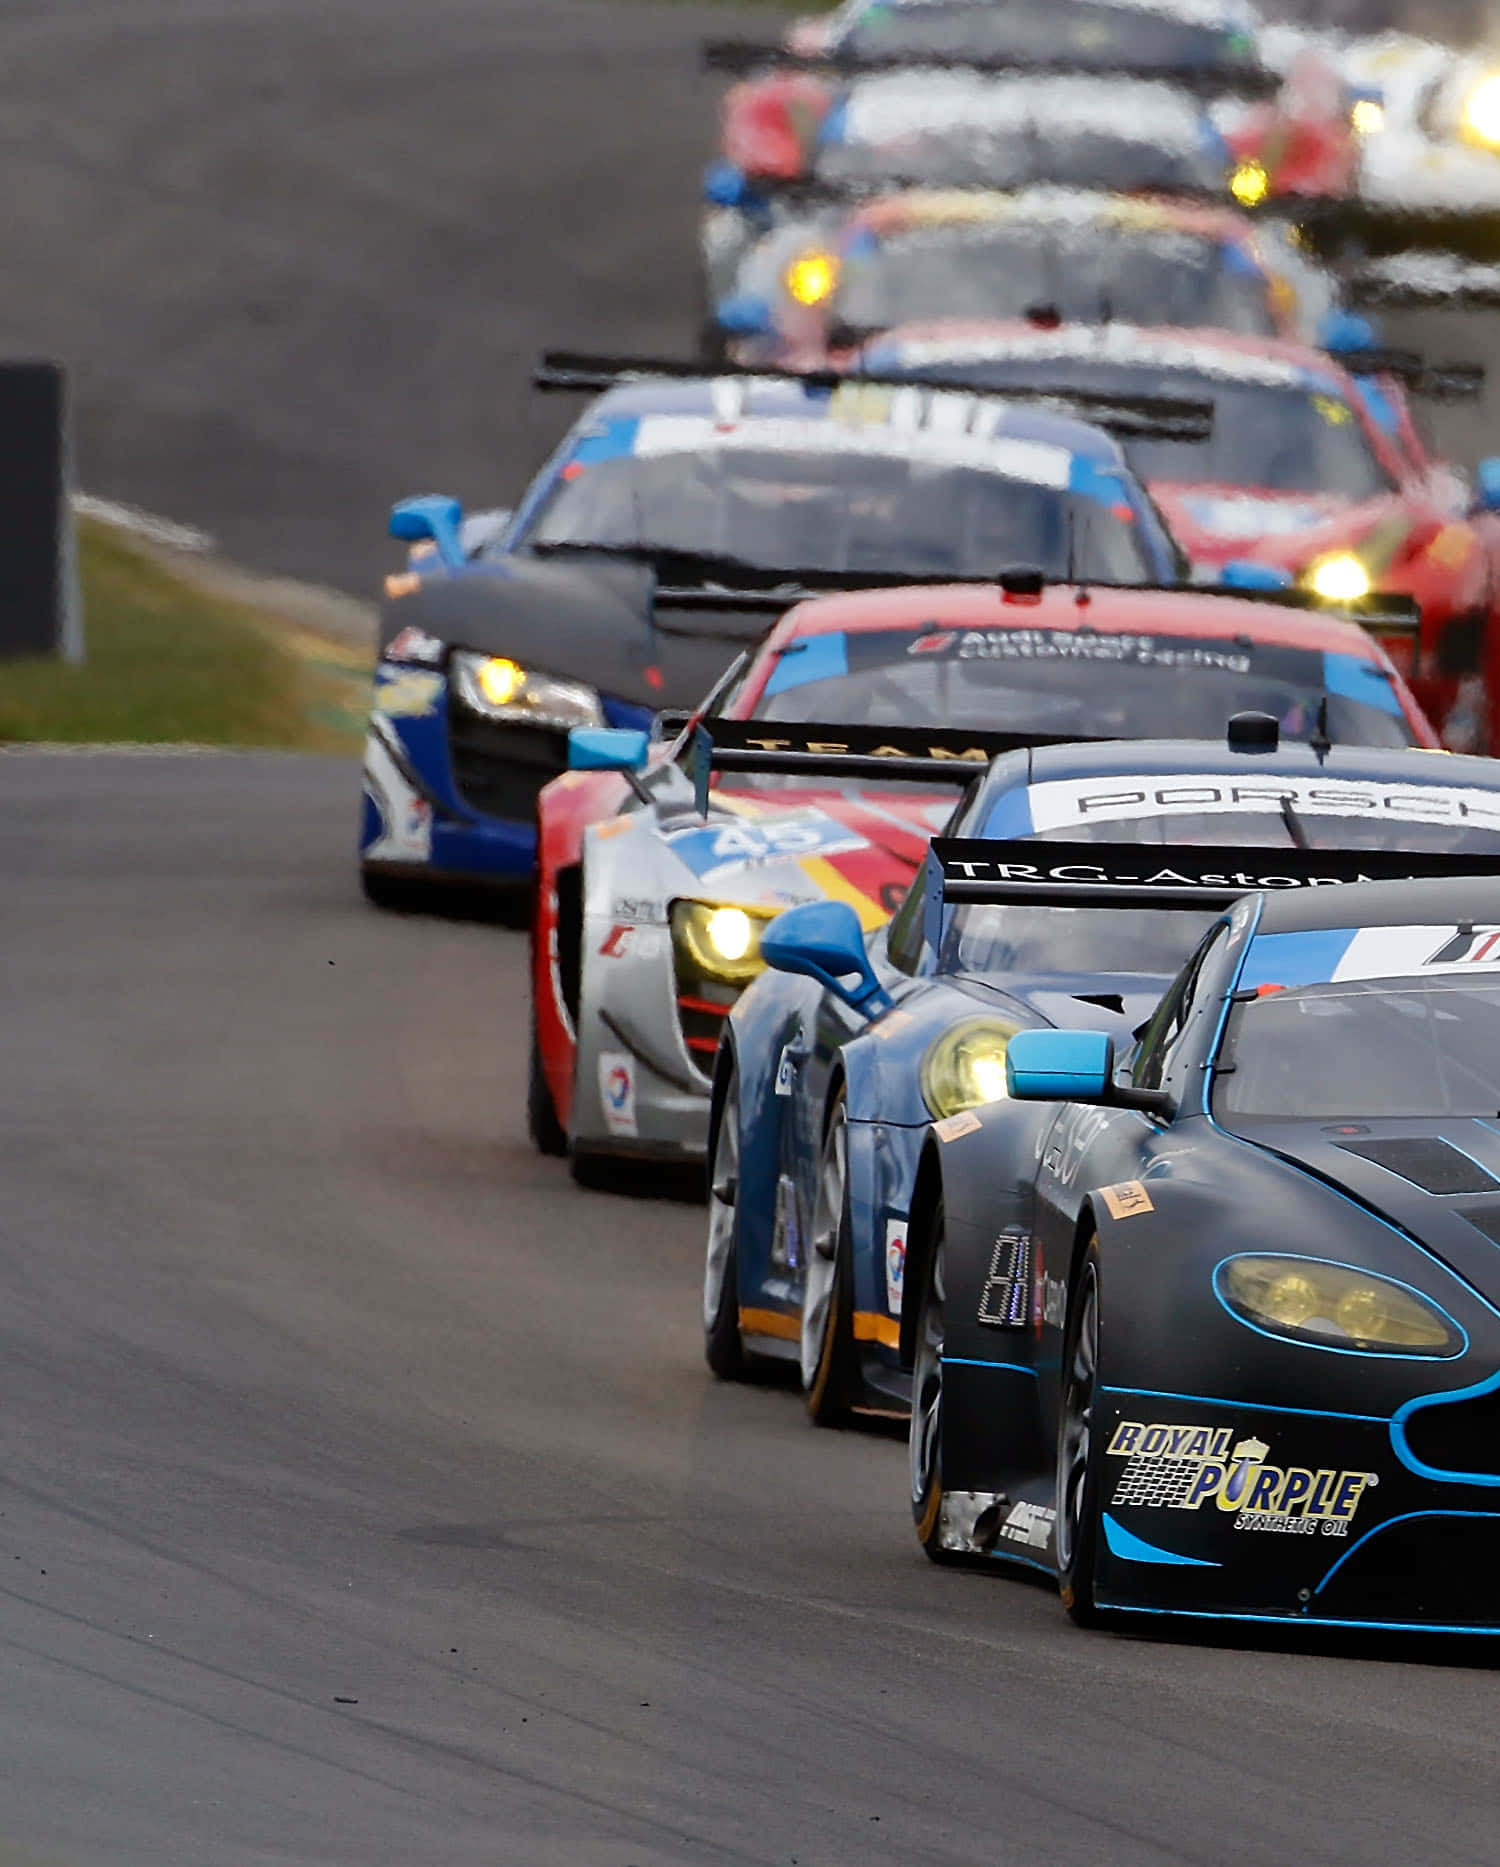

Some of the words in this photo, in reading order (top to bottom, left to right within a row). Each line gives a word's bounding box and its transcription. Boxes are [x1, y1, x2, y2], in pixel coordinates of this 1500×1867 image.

[1106, 1421, 1234, 1462] ROYAL
[1184, 1461, 1369, 1521] PURPLE
[1233, 1513, 1317, 1535] SYNTHETIC
[1320, 1518, 1349, 1537] OIL
